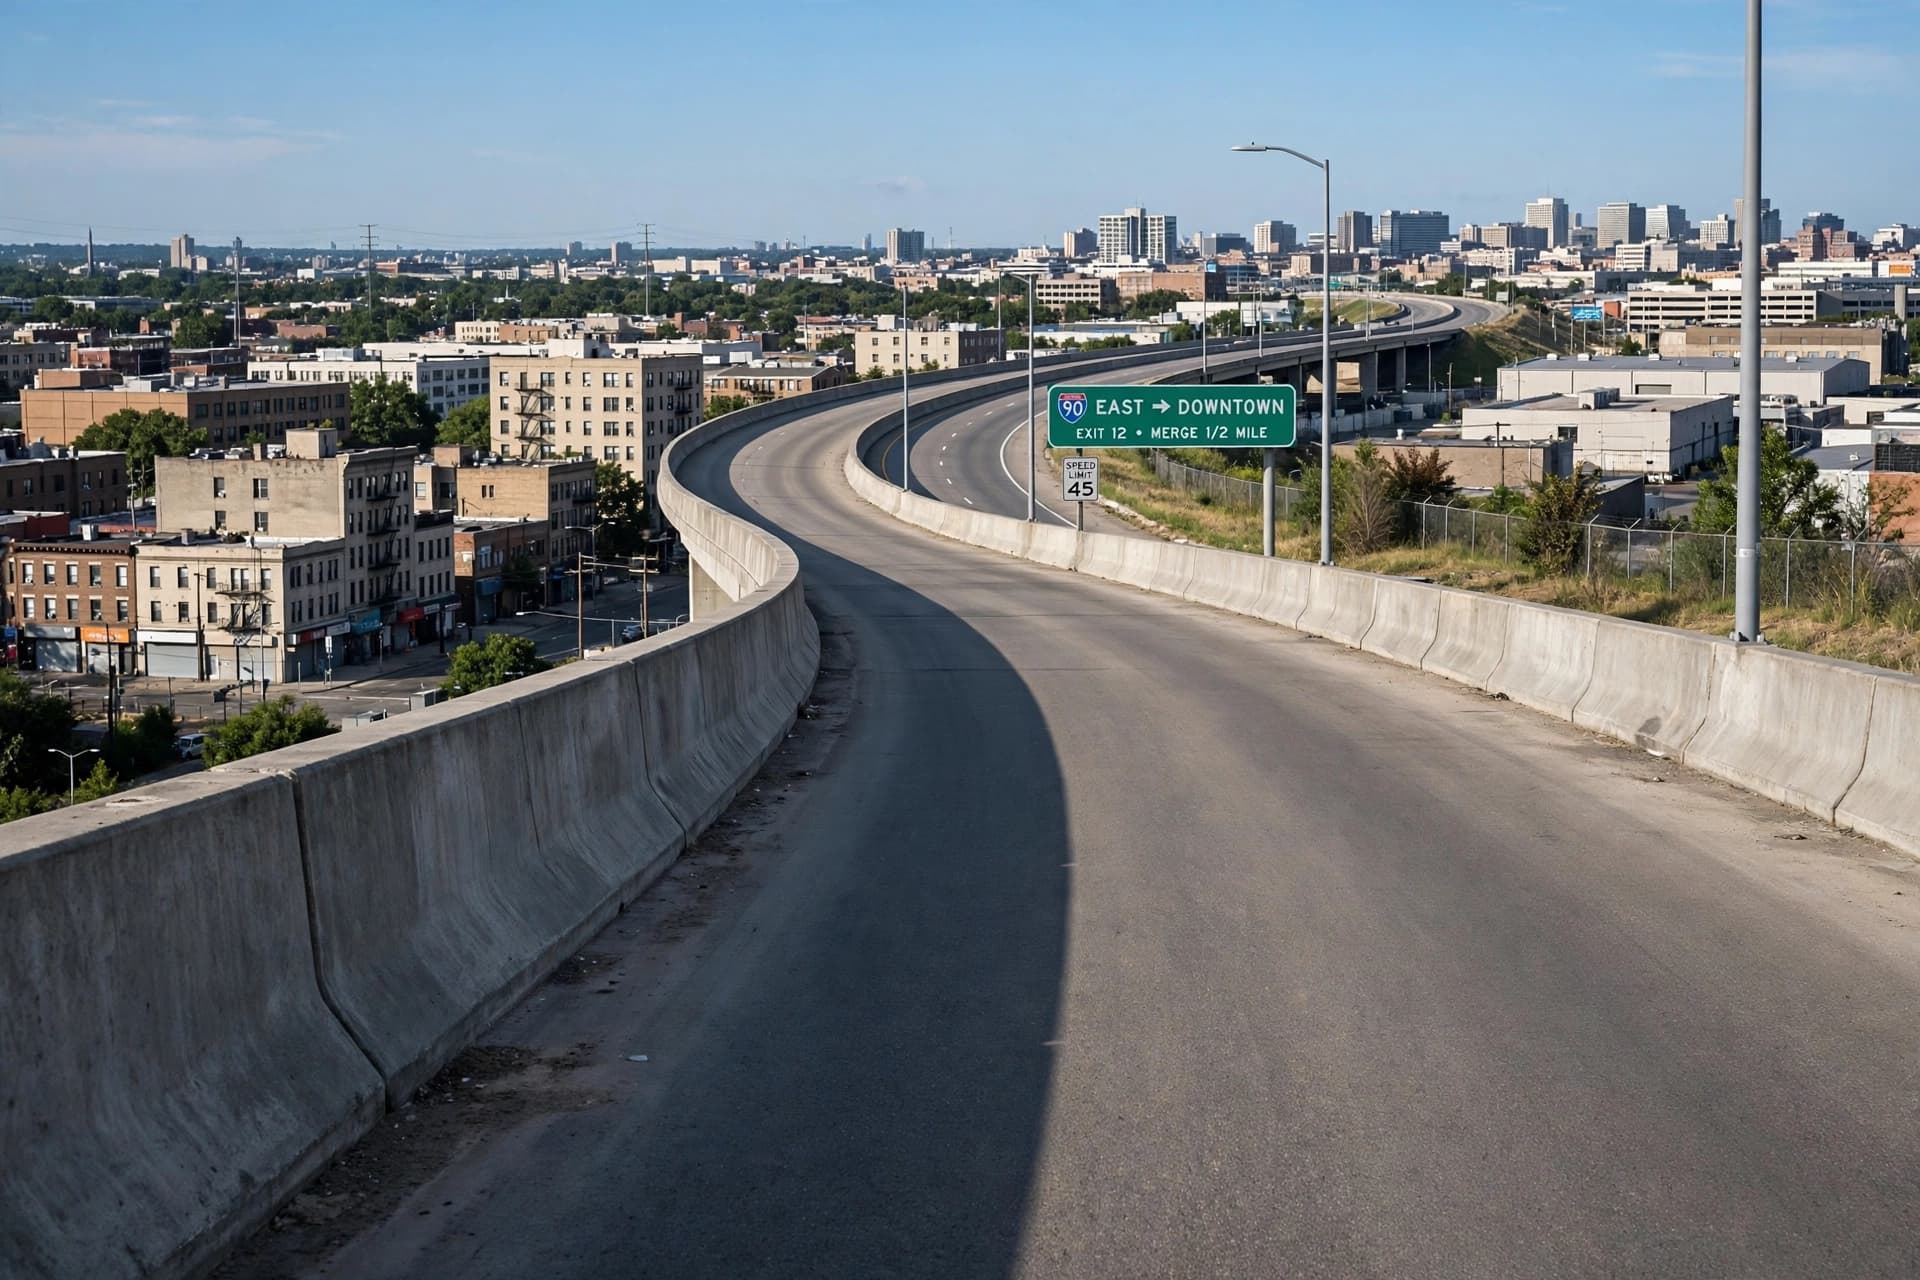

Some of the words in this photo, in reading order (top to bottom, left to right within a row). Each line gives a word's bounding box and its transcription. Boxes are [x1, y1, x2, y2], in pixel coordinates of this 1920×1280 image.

[1063, 400, 1083, 417] 90
[1096, 399, 1144, 415] EAST
[1178, 399, 1284, 415] DOWNTOWN
[1076, 427, 1104, 439] EXIT
[1112, 427, 1127, 439] 12
[1151, 427, 1198, 439] MERGE
[1206, 426, 1228, 440] 1/2
[1236, 427, 1267, 439] MILE
[1069, 471, 1092, 479] LIMIT
[1067, 481, 1094, 497] 45
